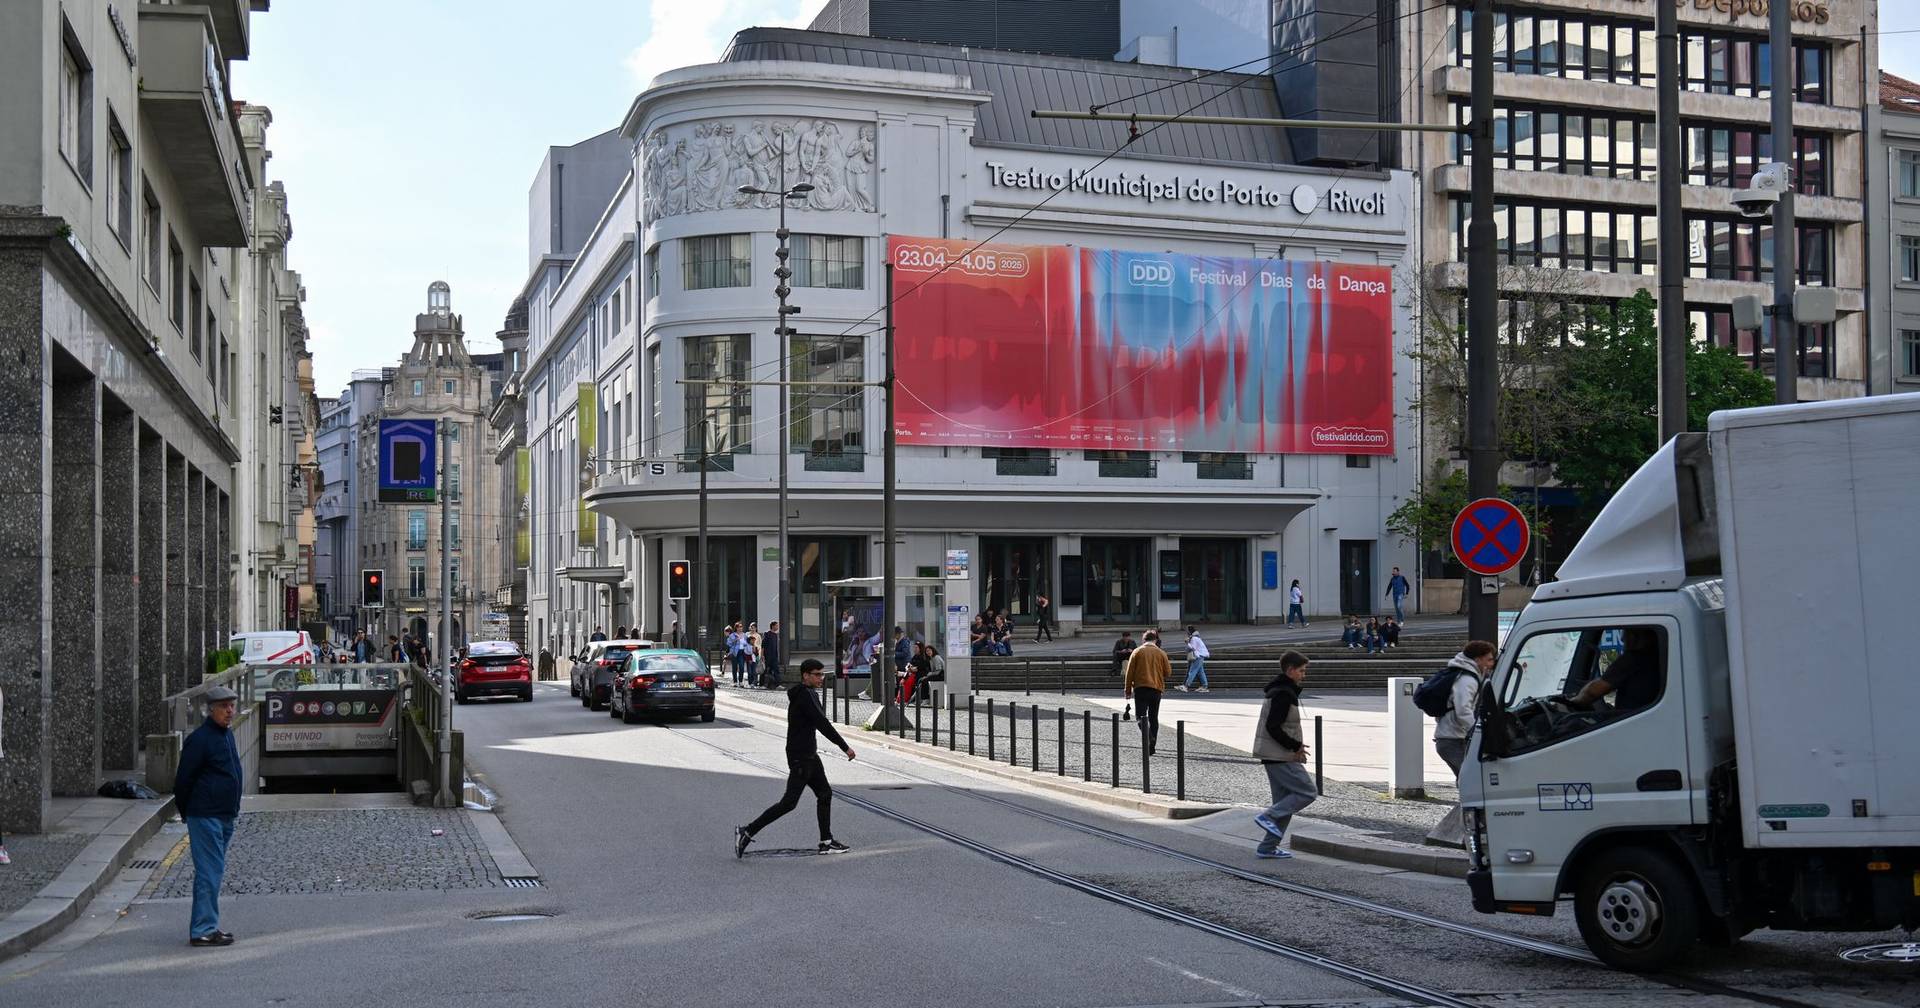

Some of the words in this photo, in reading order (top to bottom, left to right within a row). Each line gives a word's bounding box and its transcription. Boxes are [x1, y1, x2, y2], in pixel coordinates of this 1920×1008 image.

[986, 161, 1065, 191] Teatro
[1069, 168, 1183, 203] Municipal
[1187, 178, 1217, 202] do
[1221, 179, 1281, 207] Porto
[1328, 188, 1387, 216] Rivoli
[1000, 259, 1022, 270] 2025
[1133, 264, 1171, 282] DDD
[1190, 267, 1247, 287] Festival
[1260, 271, 1293, 288] Dias
[1306, 274, 1326, 290] da
[1339, 275, 1387, 297] Dança
[1316, 431, 1384, 442] festivalddd.com
[651, 463, 665, 475] S
[268, 699, 283, 719] P
[273, 732, 293, 741] BEM
[295, 731, 323, 740] VINDO
